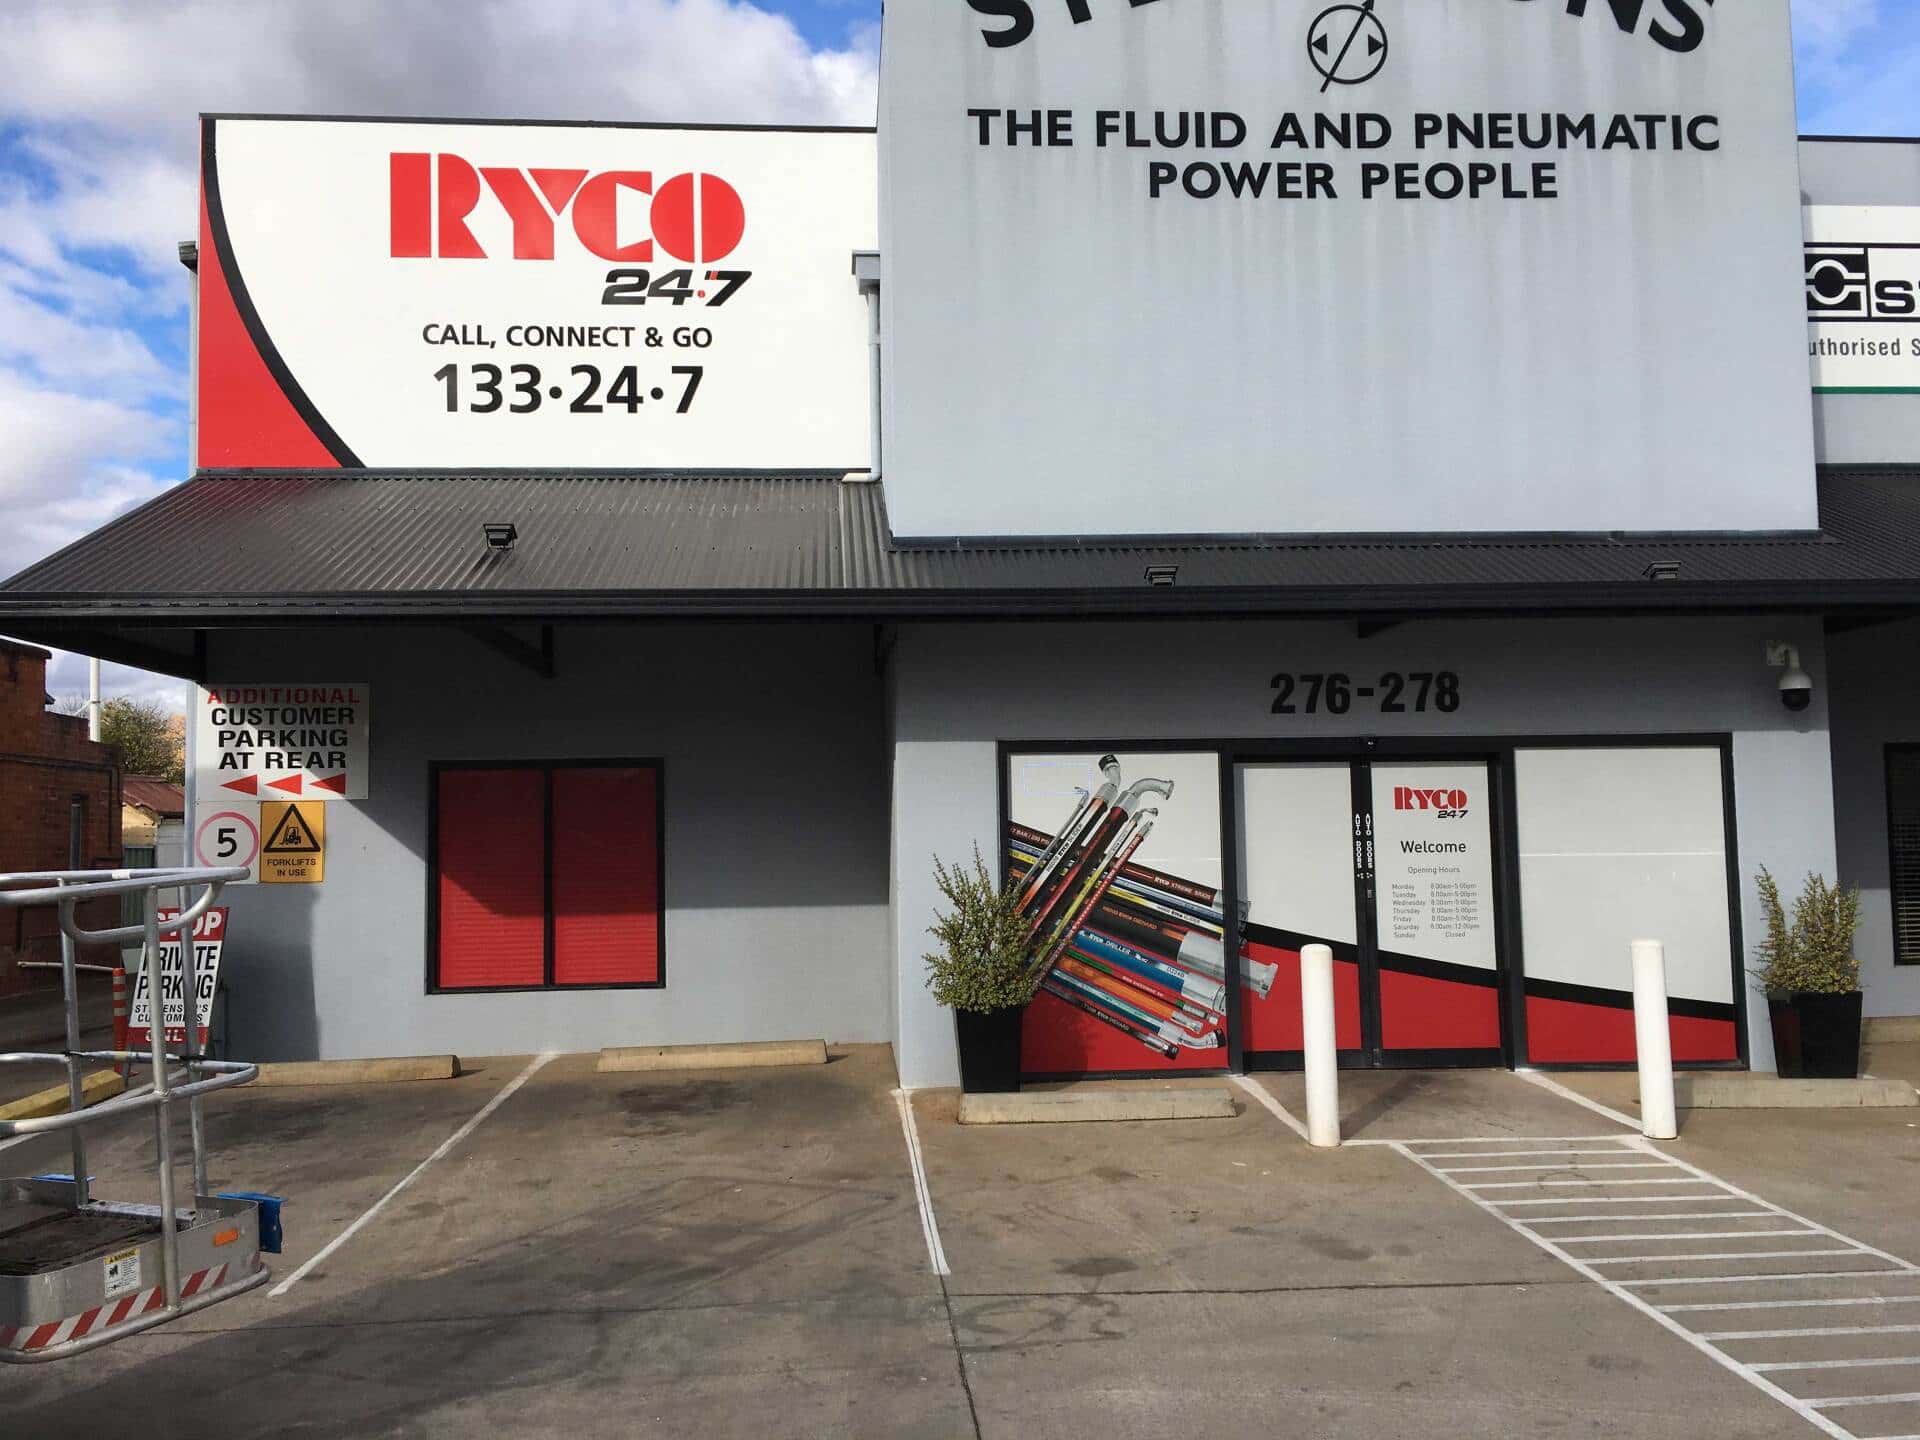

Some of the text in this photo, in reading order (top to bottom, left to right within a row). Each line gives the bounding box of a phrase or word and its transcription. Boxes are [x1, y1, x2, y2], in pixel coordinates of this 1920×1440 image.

[967, 108, 1722, 152] THE FLUID AND PNEUMATIC
[1149, 161, 1559, 200] POWER PEOPLE
[389, 152, 746, 264] RYCO
[422, 323, 712, 349] CALL, CONNECT & GO
[1809, 338, 1900, 356] uthorised
[208, 688, 360, 704] ADDITIONAL
[1270, 672, 1460, 714] 276-278
[212, 707, 355, 725] CUSTOMER
[219, 729, 348, 747] PARKING
[219, 752, 346, 769] AT REAR
[1394, 786, 1468, 810] RYCO
[217, 828, 236, 857] 5
[1401, 841, 1467, 853] Welcome
[267, 858, 316, 866] FORKLIFTS
[142, 946, 218, 971] RIVTE
